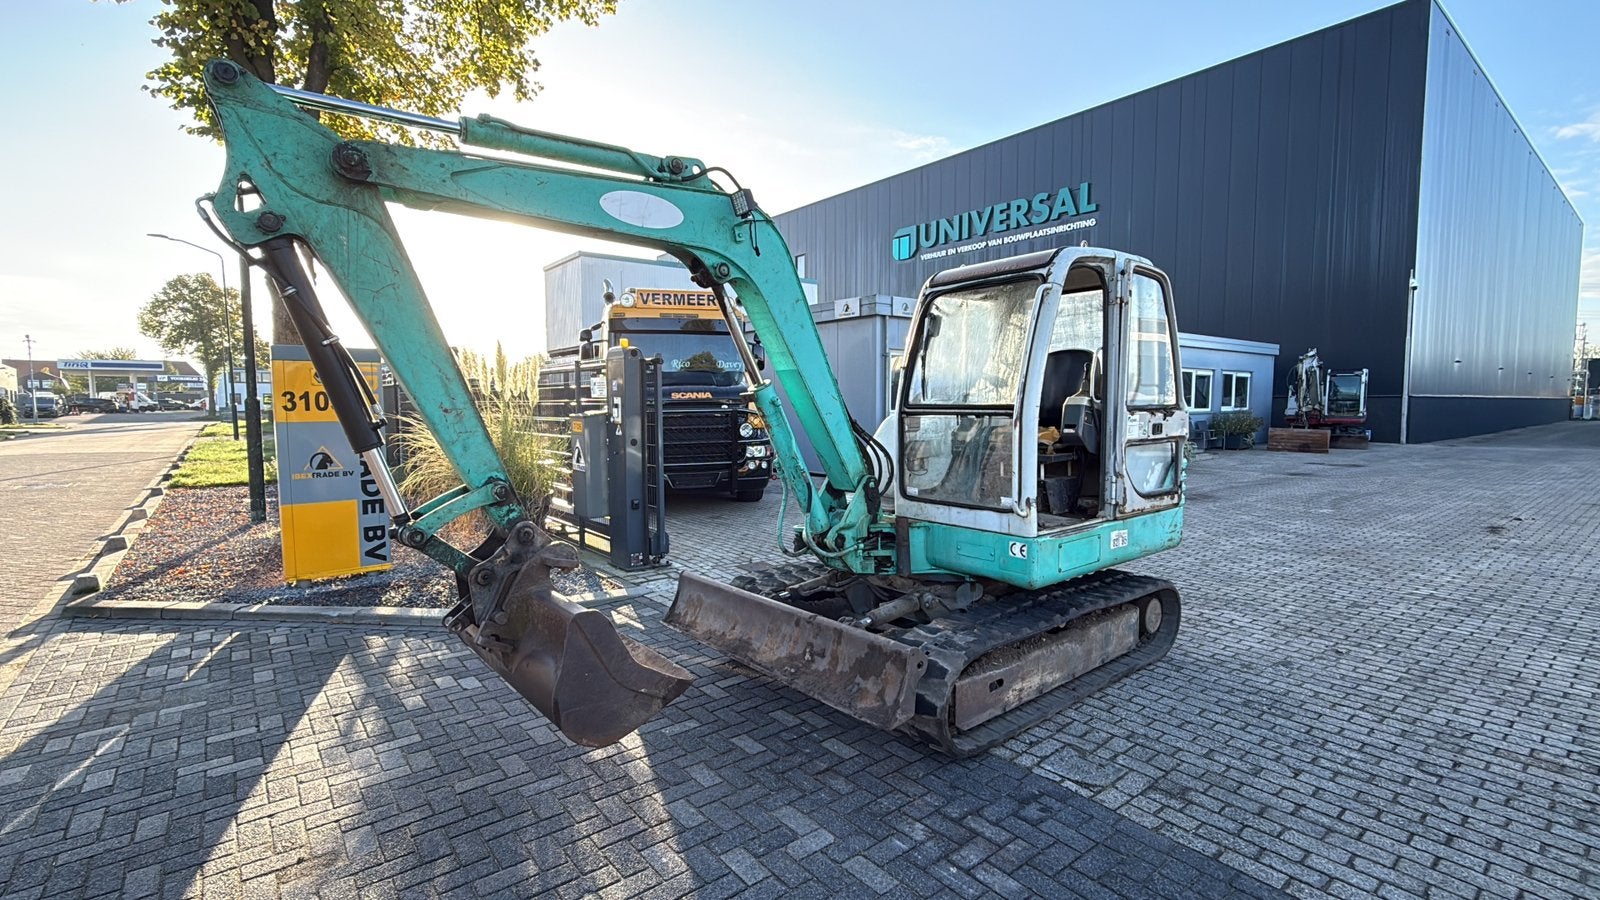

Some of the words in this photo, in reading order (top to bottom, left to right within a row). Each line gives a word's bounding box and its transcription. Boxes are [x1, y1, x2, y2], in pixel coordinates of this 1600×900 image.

[919, 182, 1097, 249] UNIVERSAL
[920, 248, 947, 261] VERHUUR
[947, 246, 957, 256] EN
[957, 241, 987, 255] VERKOOP
[987, 237, 1003, 248] VAN
[1003, 218, 1097, 244] BOUWPLAATSINRICHTING
[640, 292, 718, 307] VERMEER
[671, 359, 691, 369] Rico
[716, 360, 743, 369] Davey
[281, 391, 334, 412] 310
[363, 525, 387, 562] BV
[1010, 542, 1027, 558] CE
